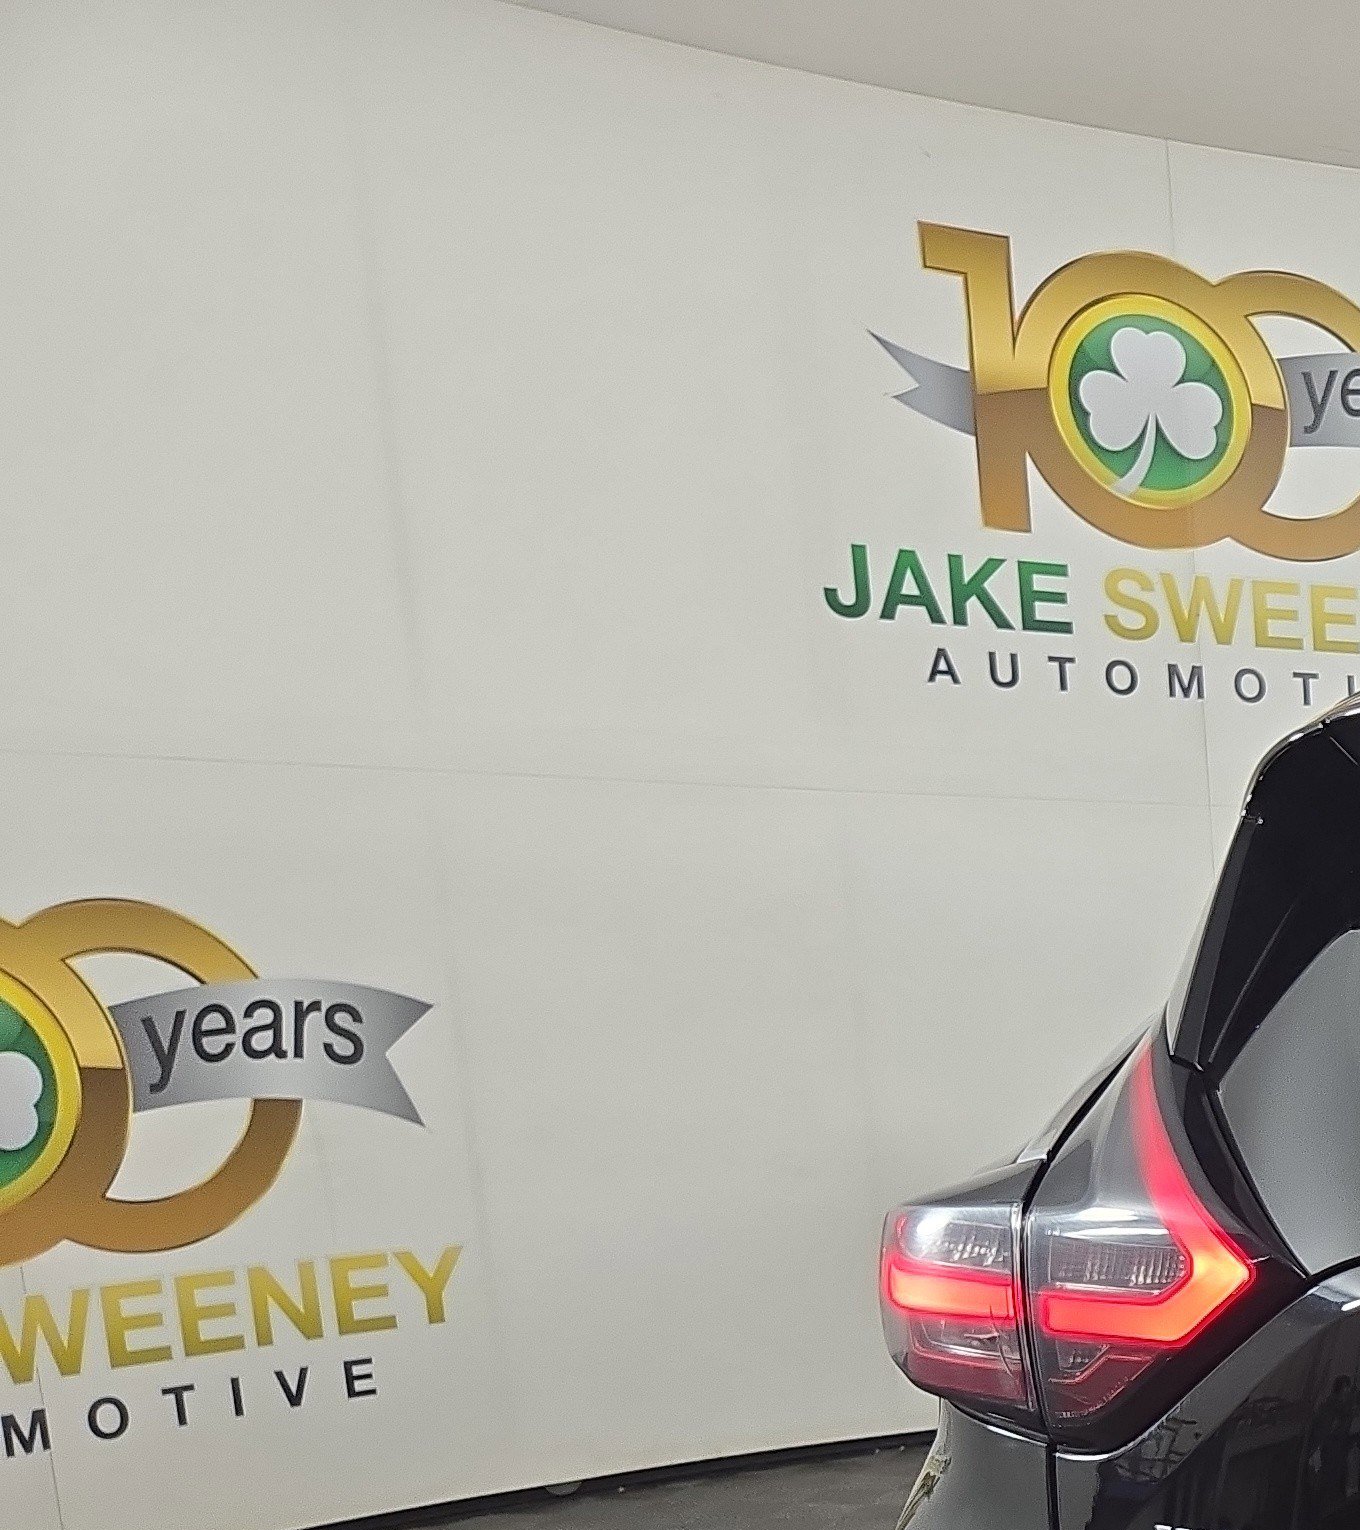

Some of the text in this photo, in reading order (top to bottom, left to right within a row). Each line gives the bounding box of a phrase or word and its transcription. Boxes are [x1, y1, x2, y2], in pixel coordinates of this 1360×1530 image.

[824, 544, 1075, 635] JAKE
[141, 997, 365, 1092] years
[1, 1357, 378, 1457] MOTIVE
